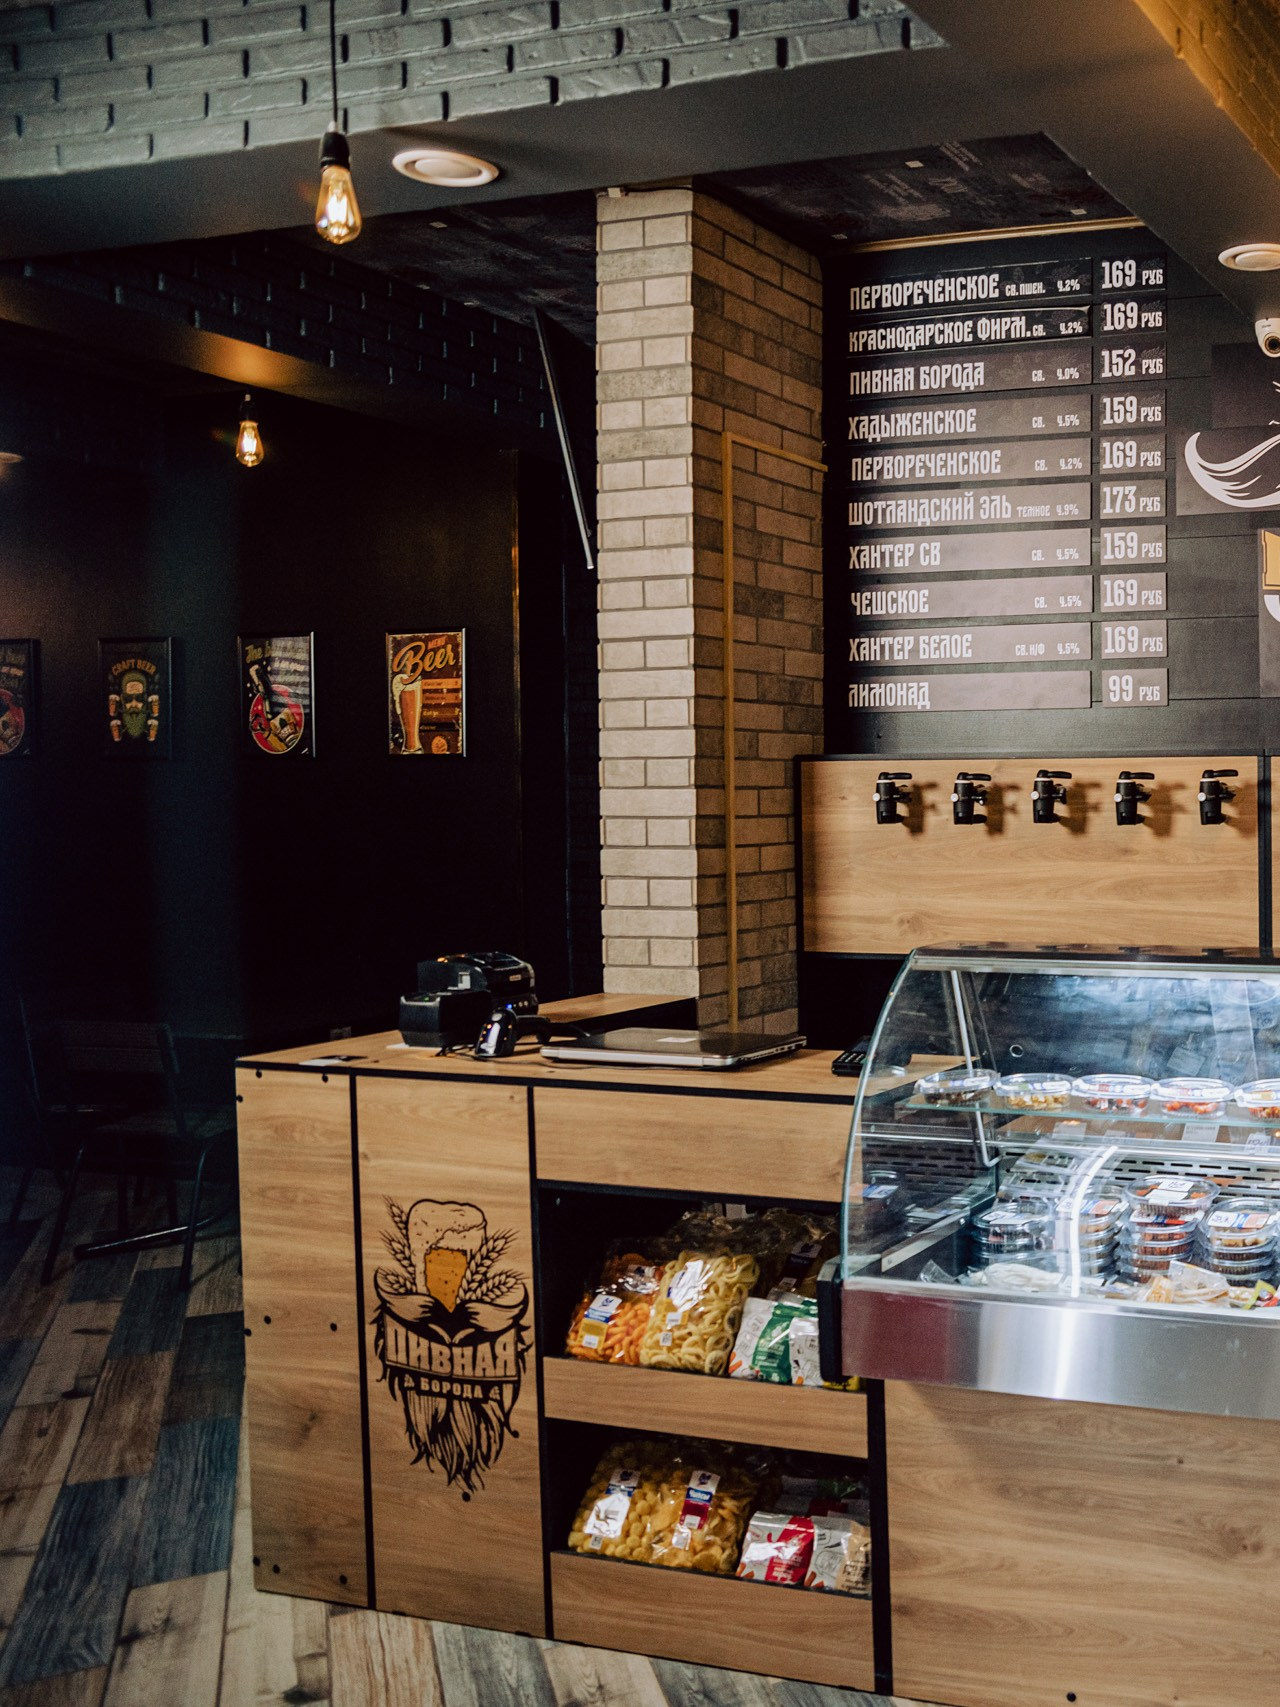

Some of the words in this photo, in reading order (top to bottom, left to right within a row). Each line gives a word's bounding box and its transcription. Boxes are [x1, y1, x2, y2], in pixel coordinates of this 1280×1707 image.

[1101, 260, 1136, 289] 169
[1142, 270, 1164, 286] РУБ
[850, 274, 999, 310] ПЕРВОРЕЧЕНСКОЕ
[1057, 279, 1080, 292] 4.2%
[1103, 302, 1138, 330] 169
[1141, 312, 1162, 328] РУБ
[850, 321, 973, 352] КРАСНОДАРСКОЕ
[977, 316, 1031, 342] ФИРМ.
[1032, 324, 1046, 336] СВ.
[1060, 322, 1082, 334] 4.2%
[1101, 349, 1136, 378] 152
[1142, 358, 1164, 374] РУБ
[850, 368, 914, 395] ПИВНАЯ
[920, 362, 984, 391] БОРОДА
[1032, 370, 1045, 382] СВ.
[1056, 368, 1080, 380] 4.0%
[1102, 396, 1137, 424] 159
[1140, 406, 1162, 422] РУБ
[848, 409, 977, 442] ХАДЫЖЕНСКОЕ
[1032, 416, 1045, 428] СВ.
[852, 450, 1001, 481] ПЕРВОРЕЧЕНСКОЕ
[1034, 459, 1048, 472] СВ.
[1060, 458, 1082, 470] 4.2%
[1102, 440, 1137, 468] 169
[1140, 451, 1161, 467] РУБ
[849, 492, 974, 526] ШОТЛАНДСКИЙ
[980, 494, 1012, 519] ЭЛЬ
[1016, 505, 1050, 518] ТЕМНОЕ
[1102, 486, 1136, 514] 173
[1139, 496, 1160, 512] РУБ
[849, 545, 914, 570] ХАНТЕР
[920, 542, 940, 566] СВ
[1032, 549, 1044, 562] СВ.
[1056, 548, 1079, 560] 4.5%
[1103, 532, 1138, 560] 159
[1141, 542, 1163, 558] РУБ
[851, 590, 929, 616] ЧЕШСКОЕ
[1034, 596, 1048, 608] СВ.
[1103, 579, 1138, 606] 169
[1141, 590, 1163, 605] РУБ
[849, 636, 914, 662] ХАНТЕР
[920, 634, 972, 660] БЕЛОЕ
[1057, 643, 1080, 655] 4.5%
[1104, 626, 1138, 653] 169
[1142, 637, 1164, 652] РУБ
[392, 641, 456, 685] Beer
[848, 682, 930, 710] ЛИМОНАД
[1108, 674, 1133, 702] 99
[1139, 686, 1160, 701] РУБ
[386, 1323, 518, 1378] ПИВНАЯ
[420, 1377, 483, 1399] БОРОДА
